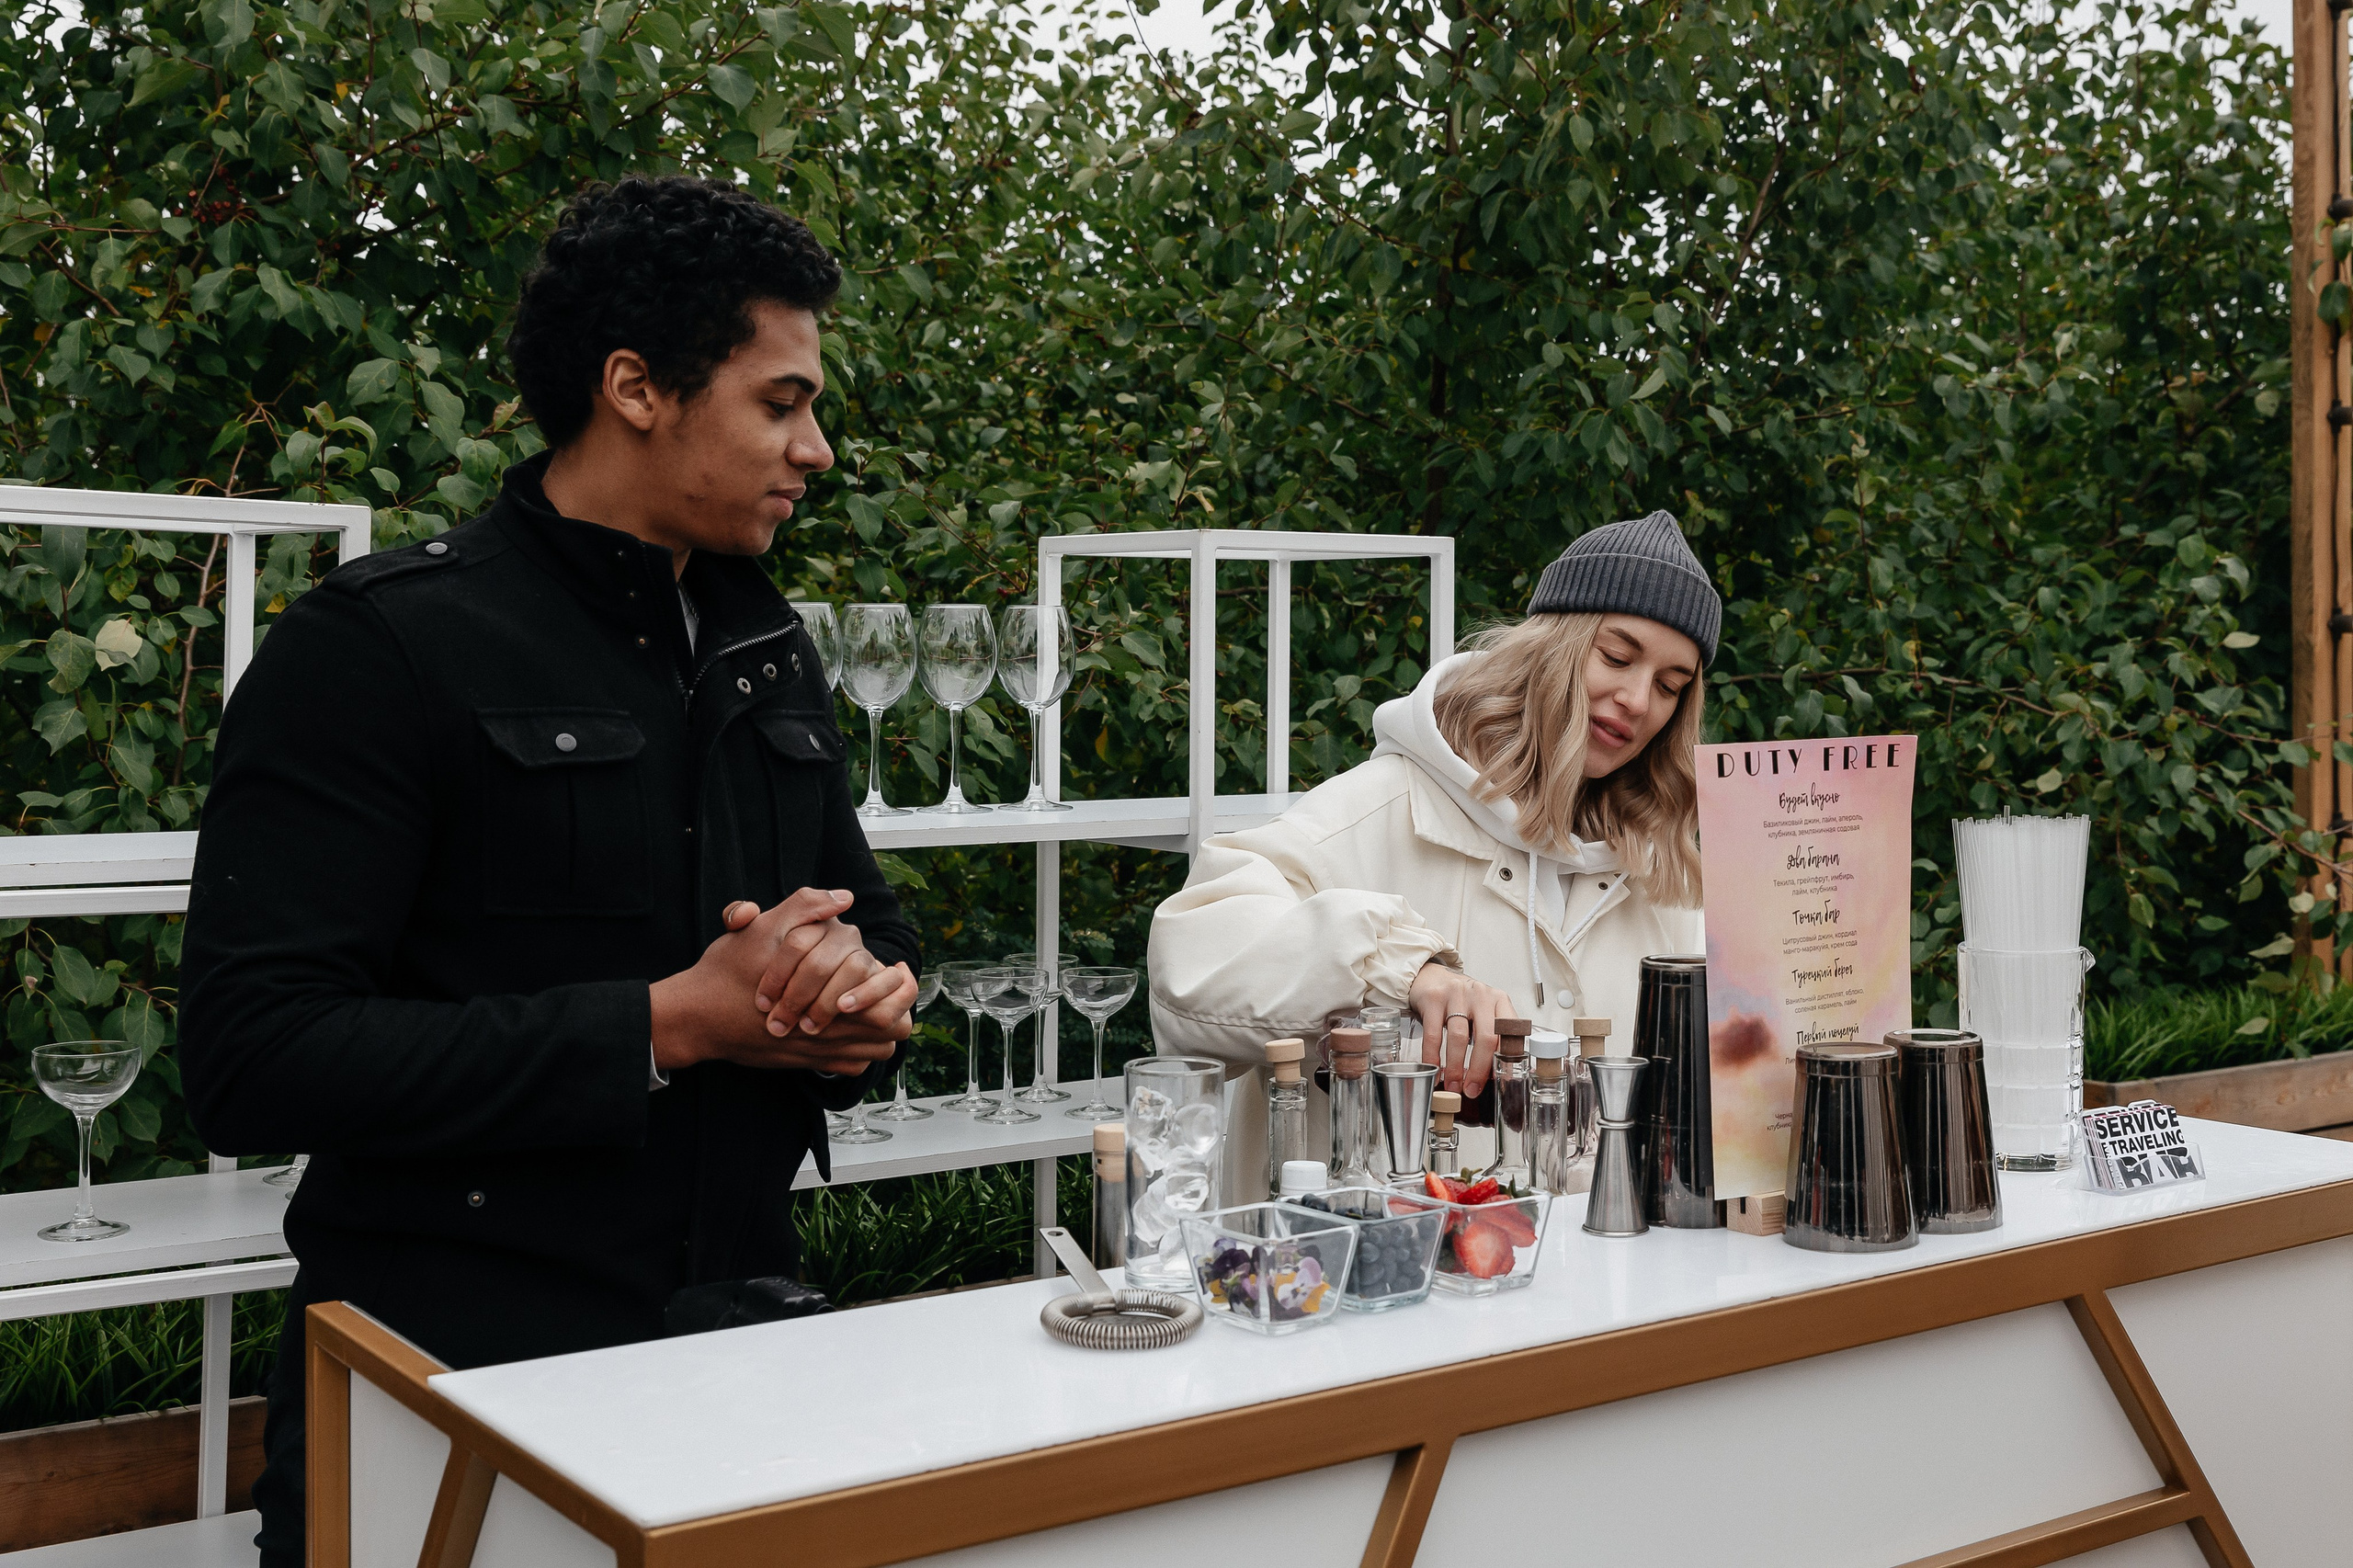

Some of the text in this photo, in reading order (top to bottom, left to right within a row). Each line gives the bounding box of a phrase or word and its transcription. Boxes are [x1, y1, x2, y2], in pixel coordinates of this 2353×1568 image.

[1716, 744, 1901, 778] DUTY FREE
[1779, 782, 1840, 813] Будет вкусно
[1763, 818, 1803, 829] Базиликовый
[1821, 815, 1838, 824] лайм,
[1838, 814, 1863, 823] апероль,
[1768, 824, 1860, 839] клубника, земляничная содовая
[1807, 846, 1840, 869] барана
[1773, 872, 1855, 888] Текила, грейпфрут, имбирь,
[1792, 885, 1838, 896] лайм, клубника
[1792, 899, 1840, 926] Точка бар
[1782, 929, 1857, 945] Цитрусовый джин, кордиал
[1783, 943, 1830, 955] манго-маракуйя,
[1845, 939, 1858, 948] сода
[1791, 958, 1853, 988] Турецкий берег
[1785, 988, 1864, 1006] Ванильный дистиллят, яблоко,
[1817, 1001, 1843, 1011] карамель,
[1843, 998, 1858, 1006] лайм
[1797, 1021, 1859, 1045] Первый поцелуй
[2095, 1107, 2179, 1139] SERVICE
[2109, 1129, 2186, 1155] TRAVELING
